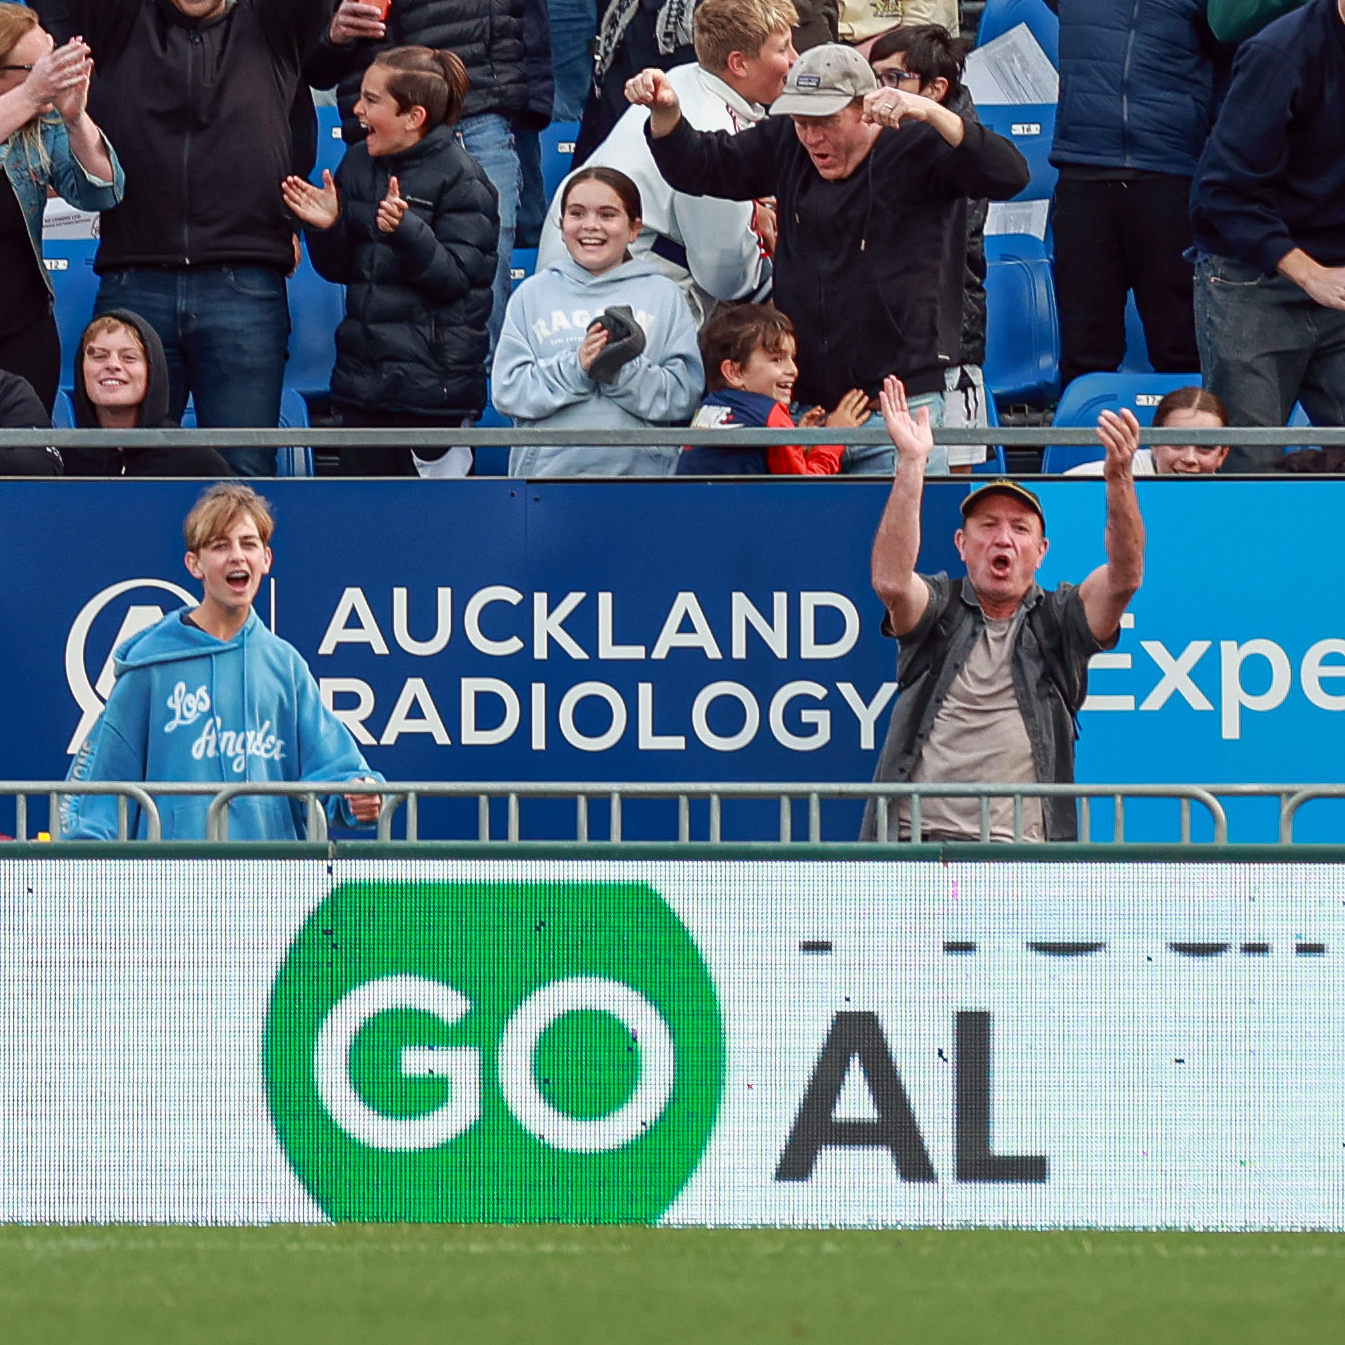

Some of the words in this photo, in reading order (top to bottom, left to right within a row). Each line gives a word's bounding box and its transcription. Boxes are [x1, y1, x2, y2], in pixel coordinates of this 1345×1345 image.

[317, 585, 861, 660] AUCKLAND
[164, 681, 211, 733] Los
[191, 716, 286, 773] Angeles
[319, 677, 899, 752] RADIOLOGY
[313, 974, 676, 1154] GO
[774, 1011, 1048, 1184] AL
